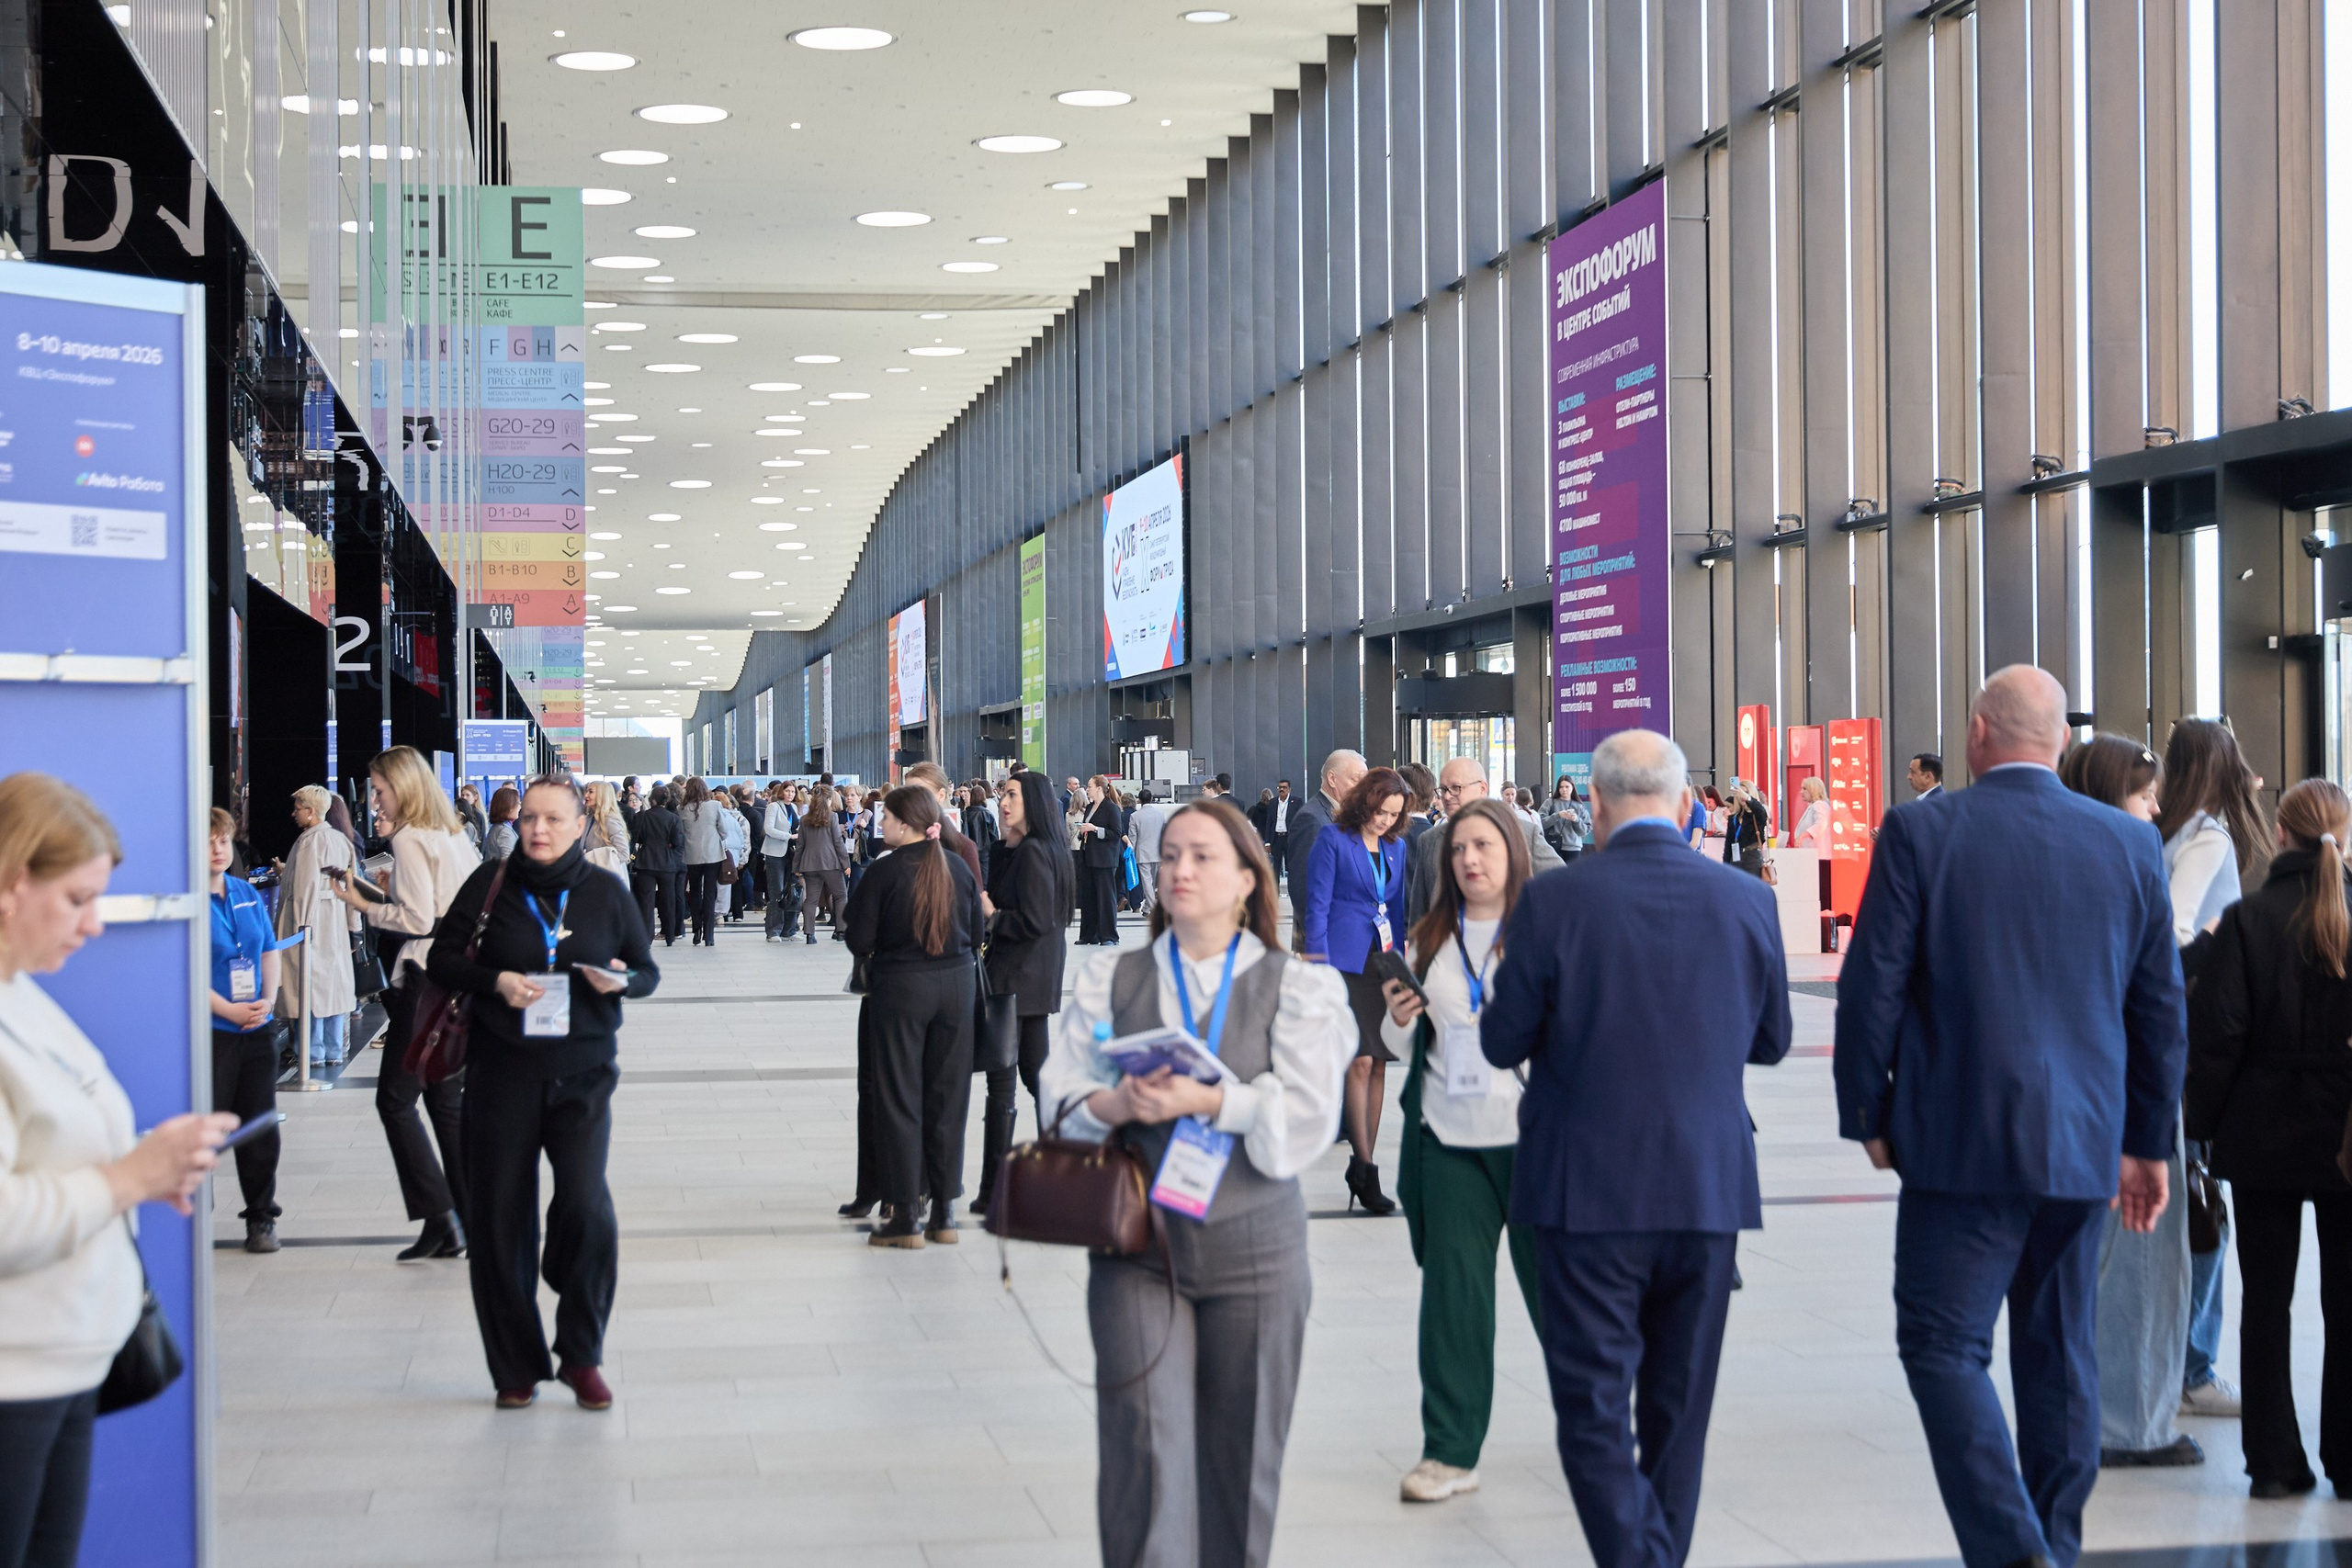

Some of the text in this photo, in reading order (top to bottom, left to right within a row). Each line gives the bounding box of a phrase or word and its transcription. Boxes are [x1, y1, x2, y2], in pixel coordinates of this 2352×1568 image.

[511, 197, 552, 260] E
[1556, 223, 1657, 310] ЭКСПОФОРУМ
[486, 273, 559, 289] E1-E12
[486, 299, 510, 308] CAFE
[486, 310, 514, 319] КАФЕ
[1556, 283, 1631, 343] В ЦЕНТРЕ СОБЫТИЙ
[62, 341, 120, 361] апреля
[120, 344, 164, 366] 2026
[490, 339, 551, 356] F G H
[1557, 336, 1640, 384] СОВРЕМЕННАЯ ИНФРАСТРУКТУРА
[487, 367, 554, 377] PRESS CENTRE
[487, 377, 552, 388] ПРЕСС-ЦЕНТР
[488, 418, 555, 434] G20-29
[1557, 420, 1563, 435] 3
[488, 463, 556, 480] H20-29
[119, 473, 165, 492] Работа
[488, 507, 576, 521] D1-D4 D
[1558, 517, 1572, 534] 4700
[565, 536, 575, 550] C
[1559, 544, 1599, 566] ВОЗМОЖНОСТИ
[489, 564, 576, 578] B1-B10 B
[1559, 550, 1636, 586] ДЛЯ ЛЮБЫХ МЕРОПРИЯТИЙ:
[489, 593, 577, 606] A1-A9 A
[1560, 656, 1637, 678] РЕКЛАМНЫЕ ВОЗМОЖНОСТИ:
[1571, 682, 1576, 697] 1
[1576, 682, 1586, 696] 500
[1587, 681, 1598, 695] 000
[1624, 677, 1636, 693] 150
